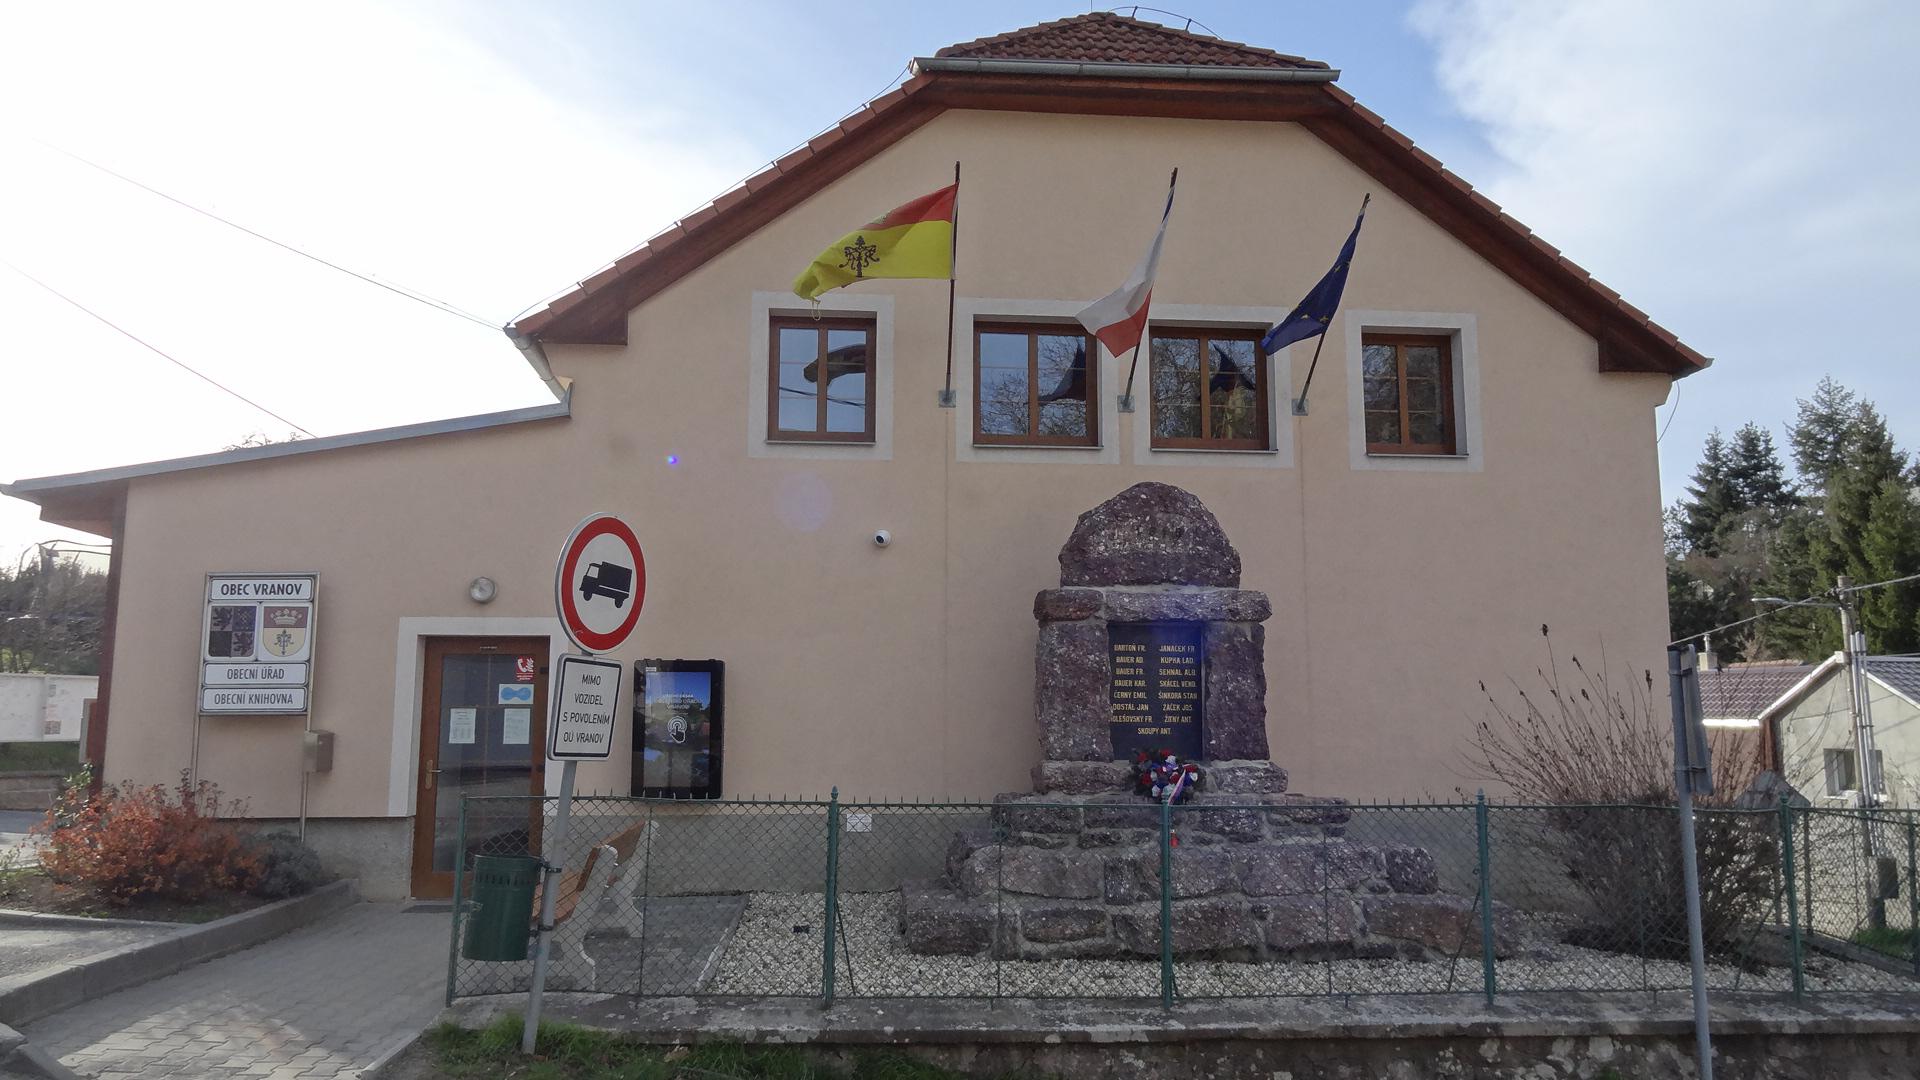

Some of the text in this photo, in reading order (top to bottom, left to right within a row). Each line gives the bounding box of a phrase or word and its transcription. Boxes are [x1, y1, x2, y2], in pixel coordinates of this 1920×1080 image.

[220, 583, 303, 596] OBEC VRANOV
[226, 665, 285, 680] OBECNÍ ÚŘAD
[581, 674, 601, 686] MIMO
[214, 691, 294, 705] OBECNÍ KNIHOVNA
[574, 692, 603, 706] VOZIDEL
[562, 711, 611, 725] S POVOLENÍM
[576, 731, 605, 744] VRANOV
